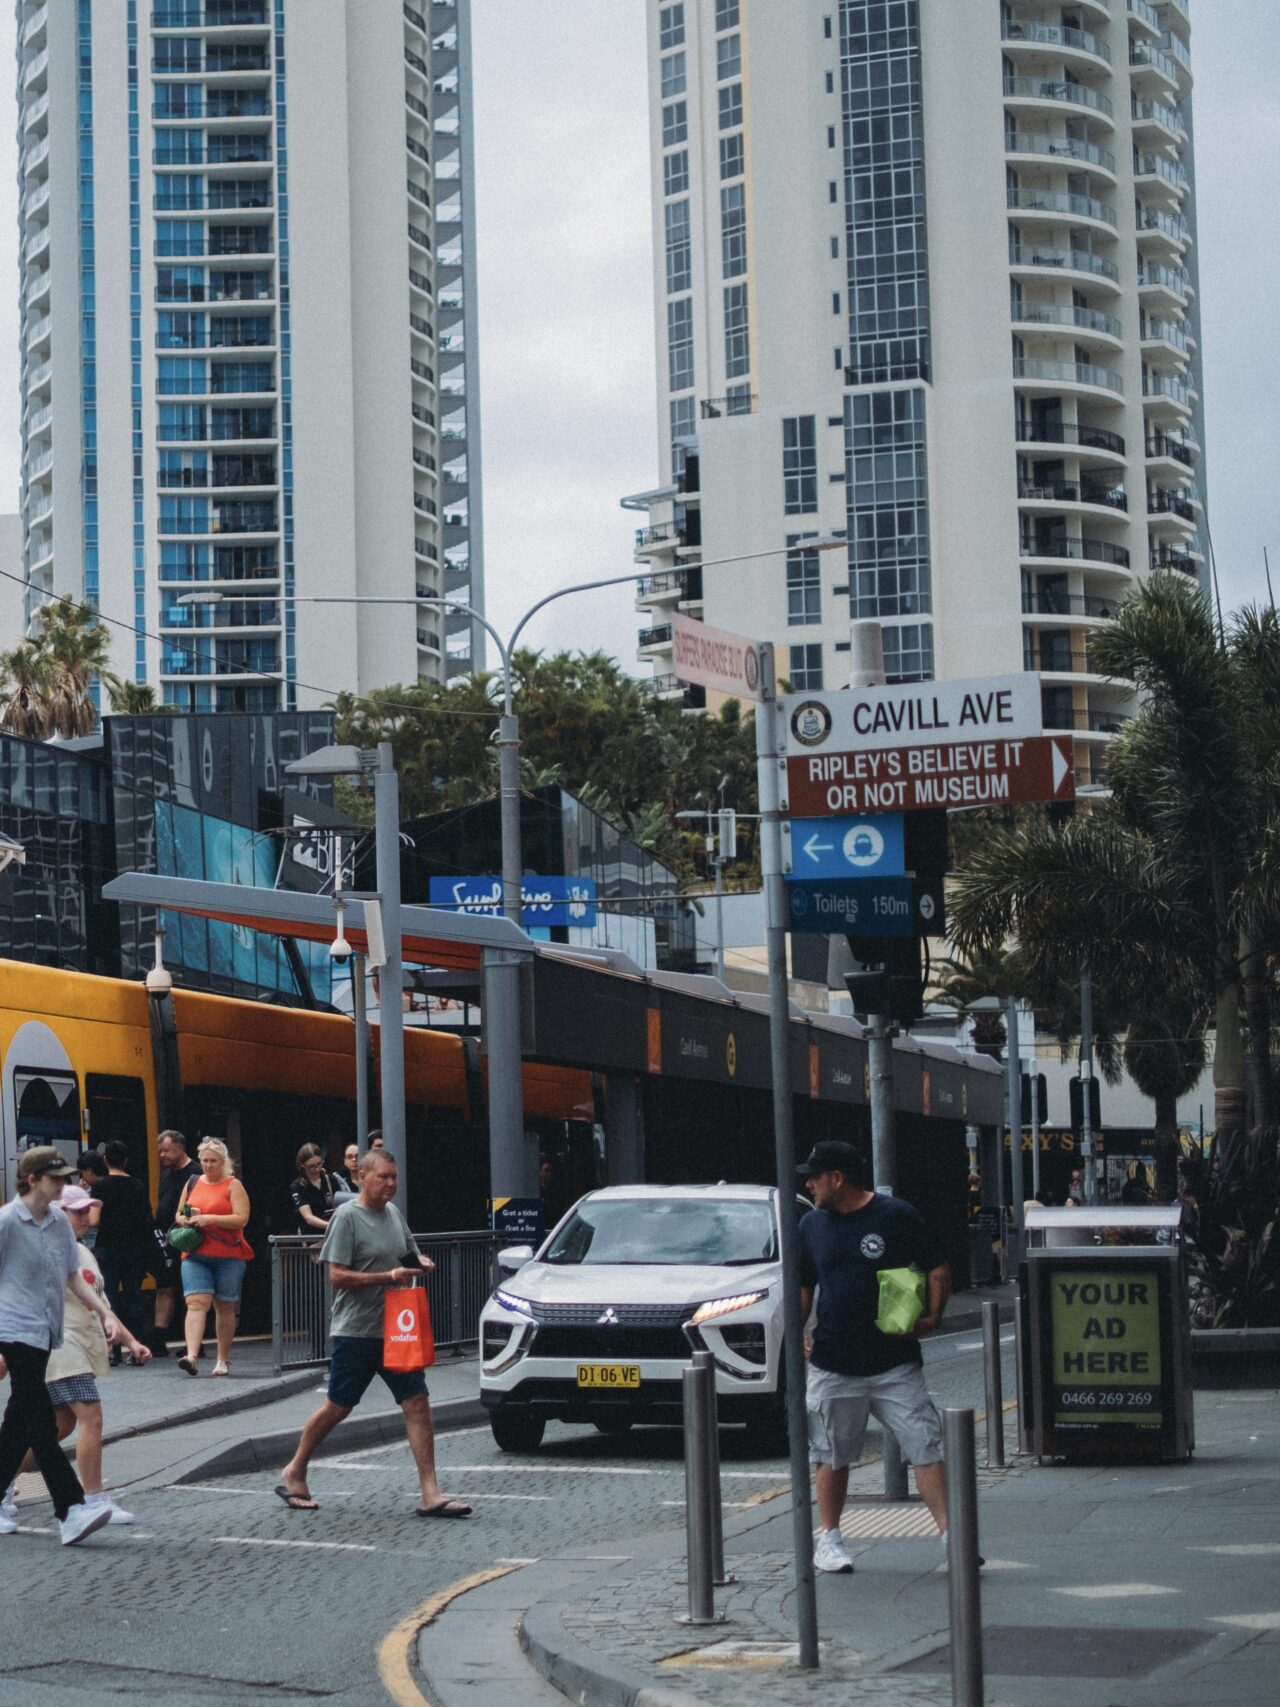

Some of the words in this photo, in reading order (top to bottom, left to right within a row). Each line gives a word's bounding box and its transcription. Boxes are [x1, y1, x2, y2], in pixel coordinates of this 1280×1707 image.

[853, 696, 949, 735] CAVILL
[959, 690, 1014, 726] AVE
[809, 751, 902, 782] RIPLEY'S
[908, 744, 997, 774] BELIEVE
[1004, 742, 1024, 767] IT
[826, 785, 858, 810] OR
[864, 781, 908, 807] NOT
[915, 773, 1009, 804] MUSEUM
[813, 893, 858, 914] Toilets
[872, 896, 909, 915] 150m
[1004, 1133, 1075, 1151] AXY'S
[1058, 1283, 1149, 1305] YOUR
[1083, 1317, 1126, 1339] AD
[1063, 1351, 1150, 1373] HERE
[579, 1367, 595, 1382] DI
[601, 1367, 617, 1382] 06
[621, 1367, 637, 1382] VE
[1062, 1392, 1096, 1405] 0466
[1099, 1392, 1124, 1405] 269
[1127, 1392, 1152, 1405] 269
